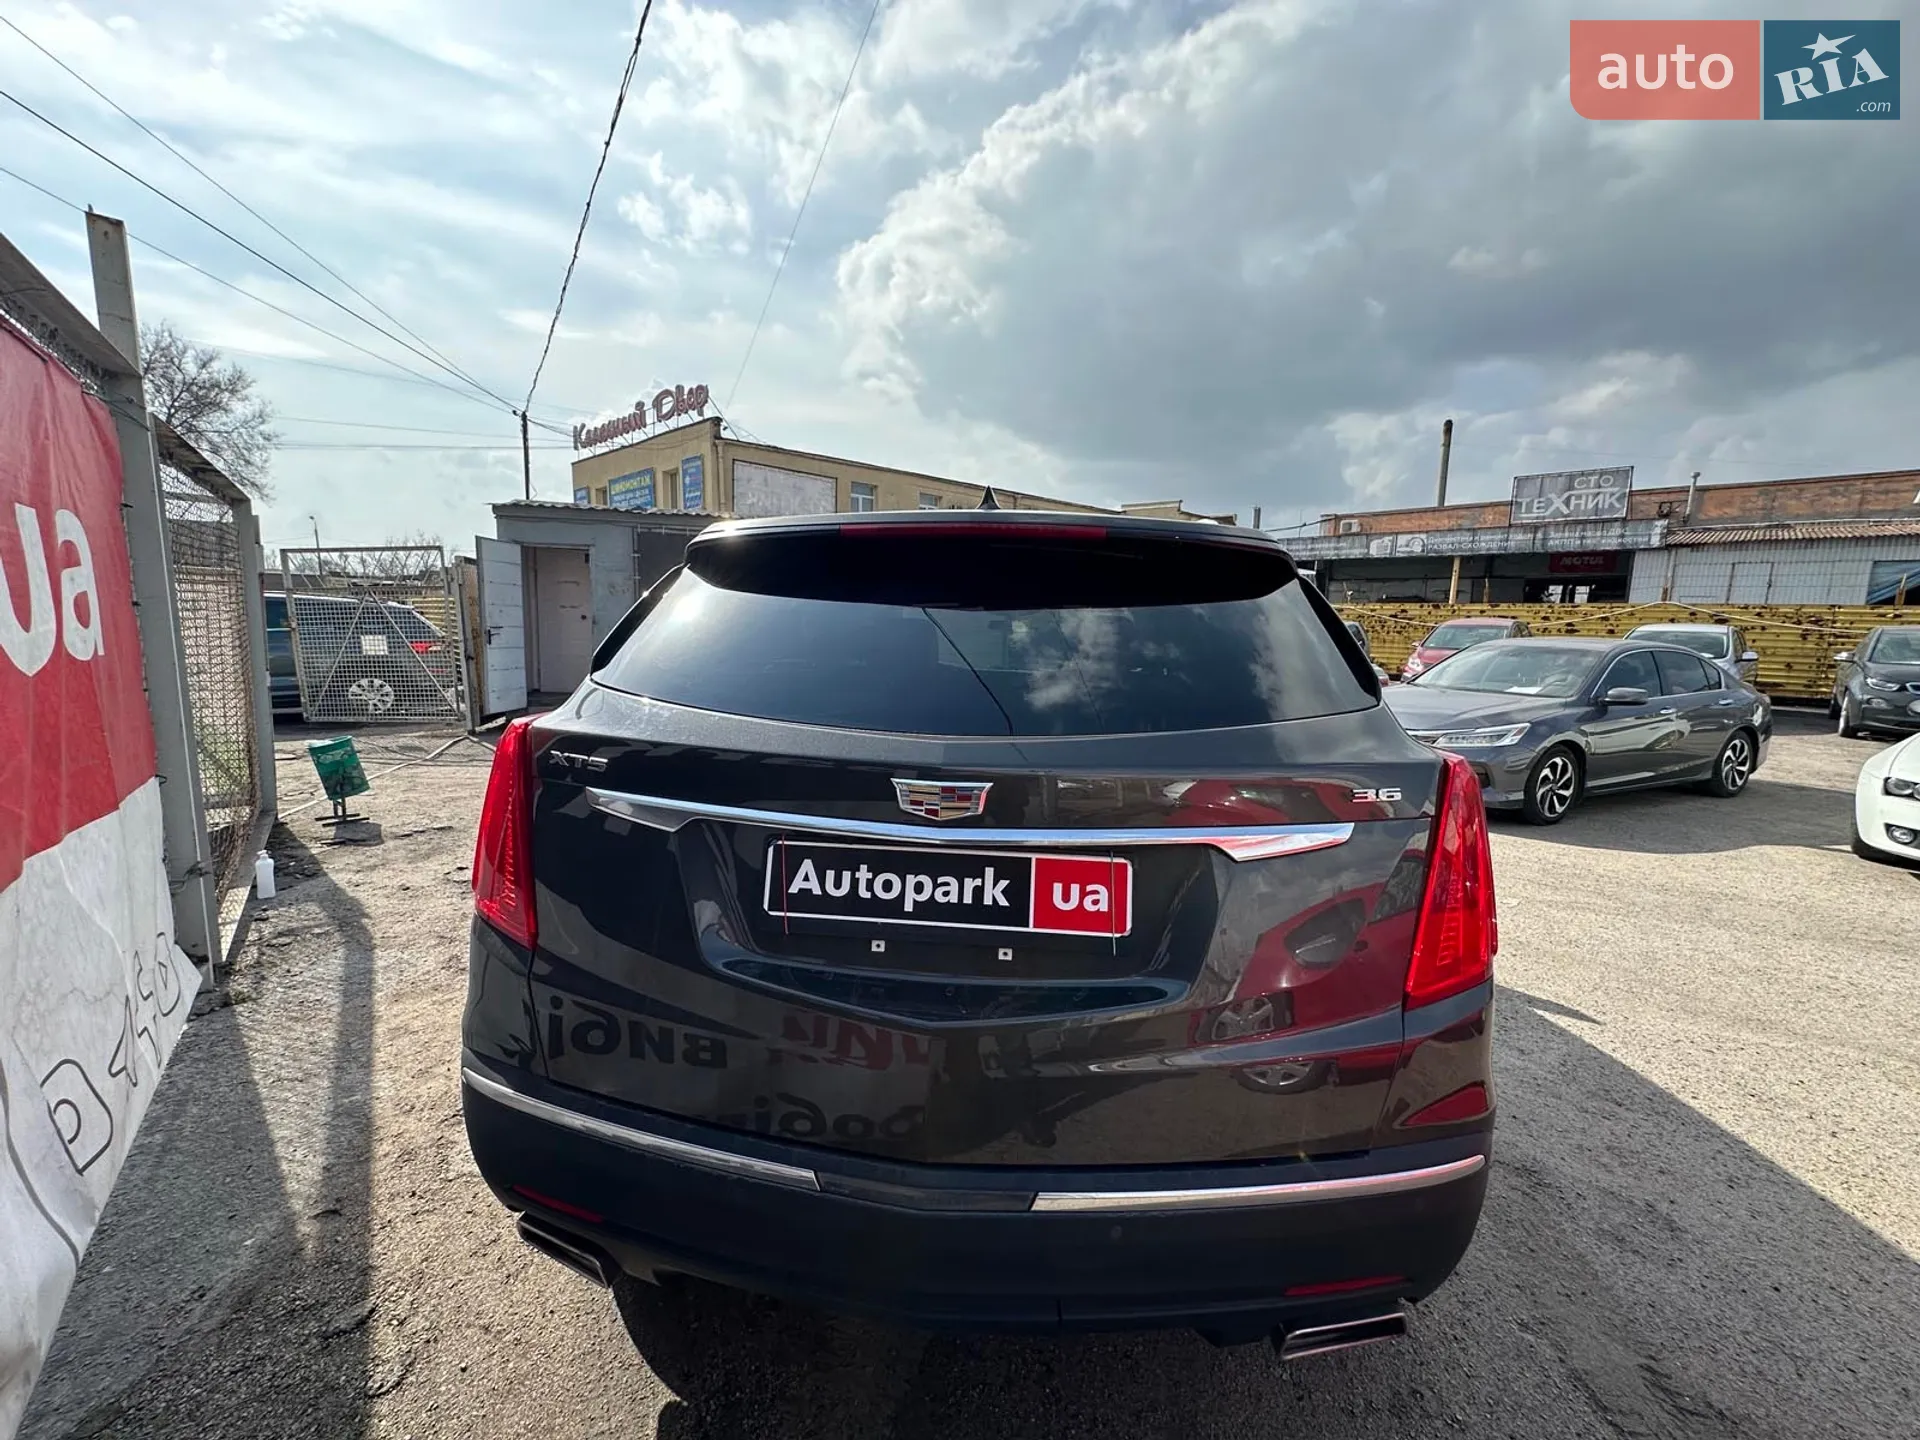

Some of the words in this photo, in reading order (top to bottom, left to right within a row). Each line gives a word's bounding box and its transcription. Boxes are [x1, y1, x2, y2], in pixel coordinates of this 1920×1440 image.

[652, 384, 709, 423] Двор
[1574, 474, 1615, 489] СТО
[1516, 487, 1623, 516] ТЕХНИК
[1560, 555, 1604, 566] MOTUL
[0, 501, 104, 677] ua
[788, 858, 1011, 912] Autopark
[1052, 881, 1109, 912] ua
